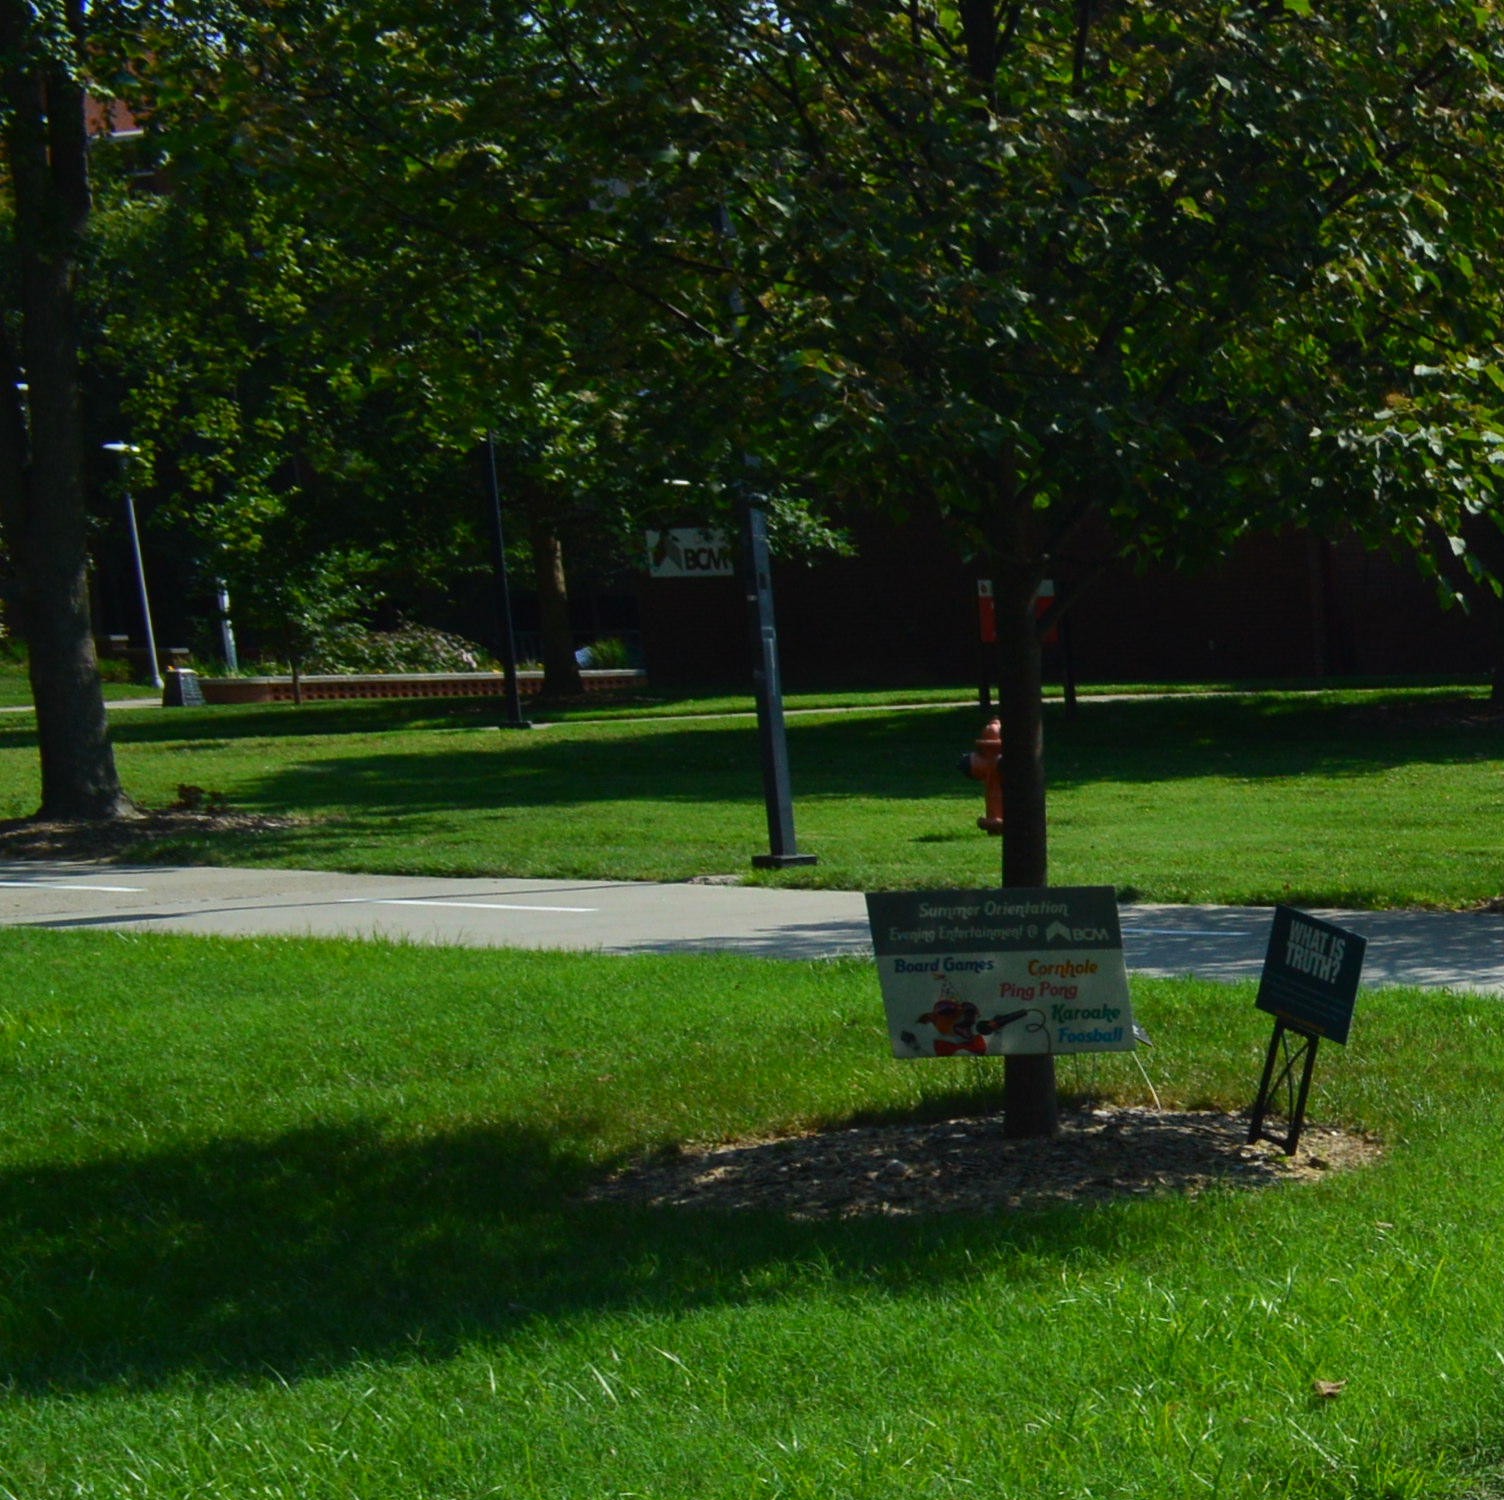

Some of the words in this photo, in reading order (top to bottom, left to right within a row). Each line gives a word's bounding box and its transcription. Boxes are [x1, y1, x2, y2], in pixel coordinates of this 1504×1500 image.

[918, 902, 980, 920] Summer
[983, 900, 1069, 919] Orientation
[889, 927, 936, 943] Evening
[939, 925, 1023, 943] Entertainment
[1027, 924, 1039, 938] @
[1071, 929, 1110, 942] BCM
[1290, 920, 1329, 953] WHAT
[1331, 936, 1345, 960] IS
[894, 958, 940, 973] Board
[942, 956, 995, 974] Games
[1027, 959, 1099, 978] Cornhole
[1286, 941, 1341, 984] TRUTH?
[999, 982, 1035, 1001] Ping
[1039, 981, 1078, 999] Pong
[1051, 1003, 1121, 1023] Karoake
[1057, 1027, 1124, 1044] Foosball
